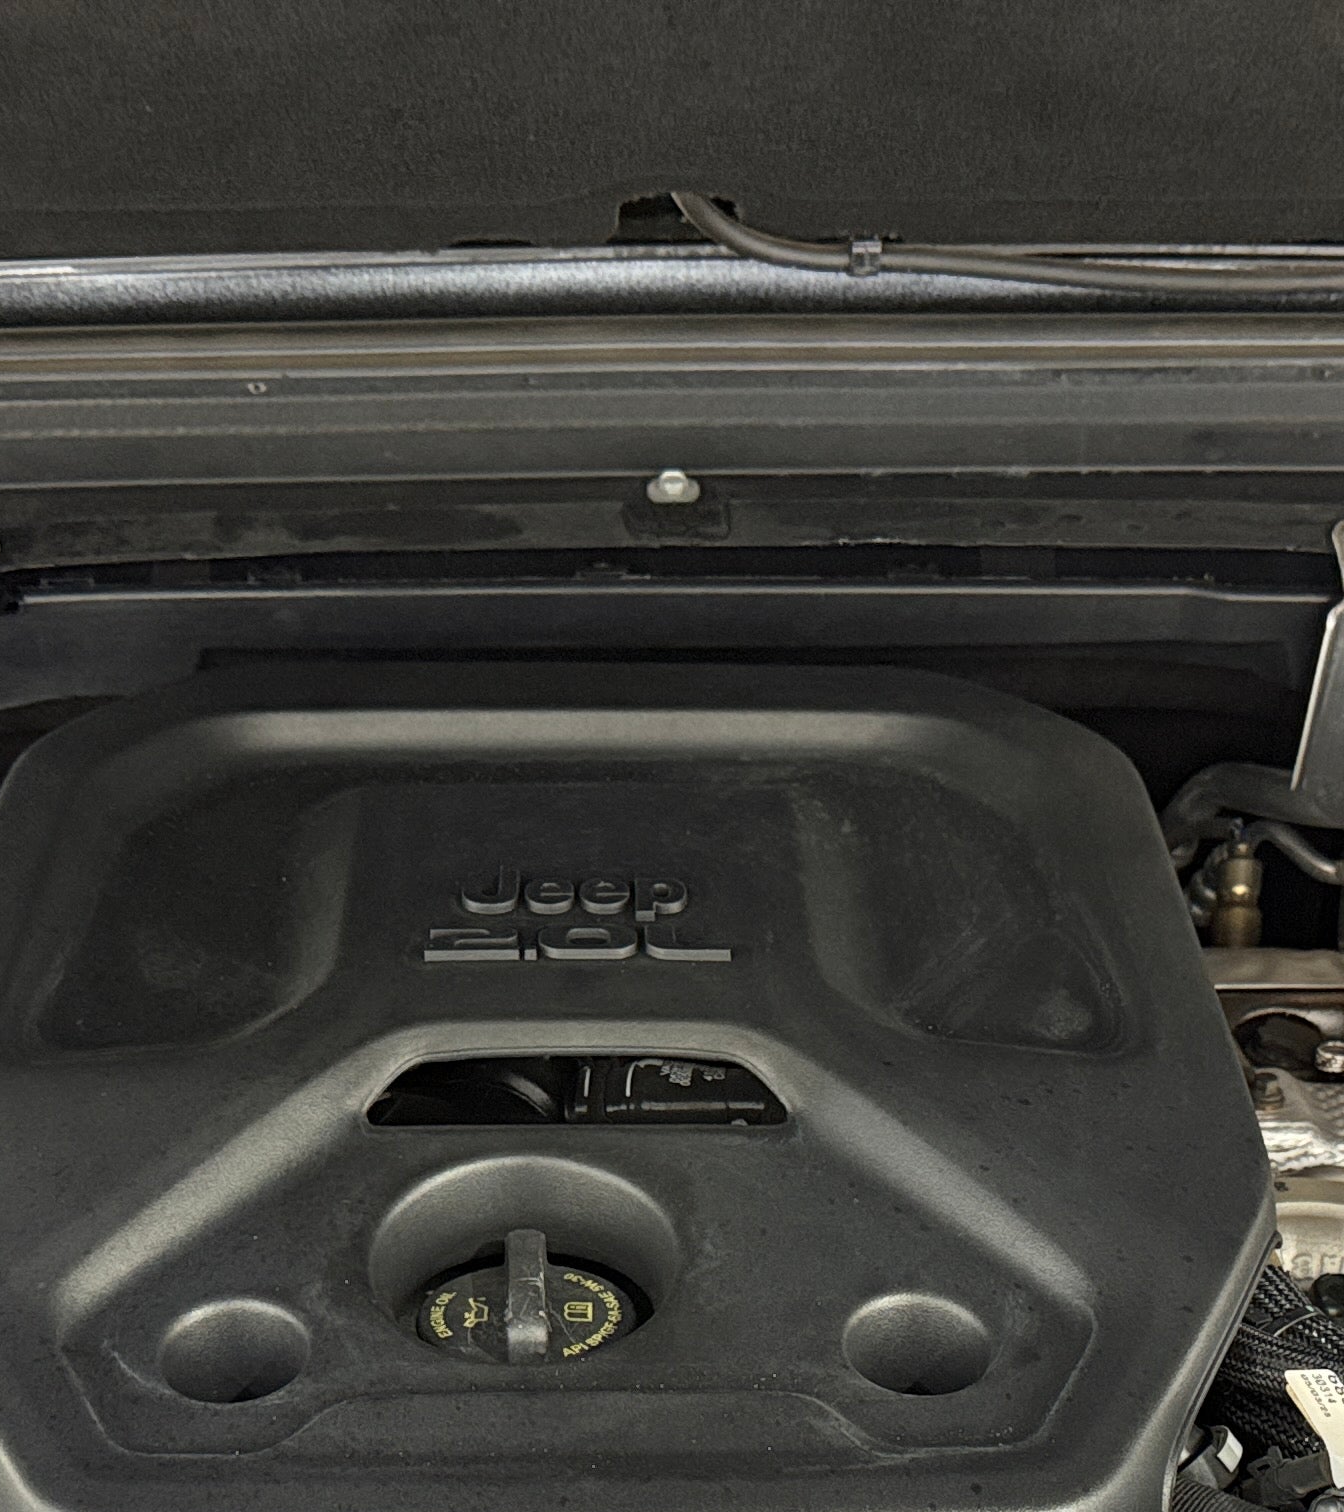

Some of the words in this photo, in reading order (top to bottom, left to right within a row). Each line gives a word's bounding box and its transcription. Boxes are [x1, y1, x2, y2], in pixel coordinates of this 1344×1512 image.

[461, 864, 688, 922] Jeep
[423, 926, 732, 963] 2.0L
[437, 1291, 458, 1306] OIL
[429, 1305, 454, 1339] ENGINE
[562, 1342, 589, 1358] API
